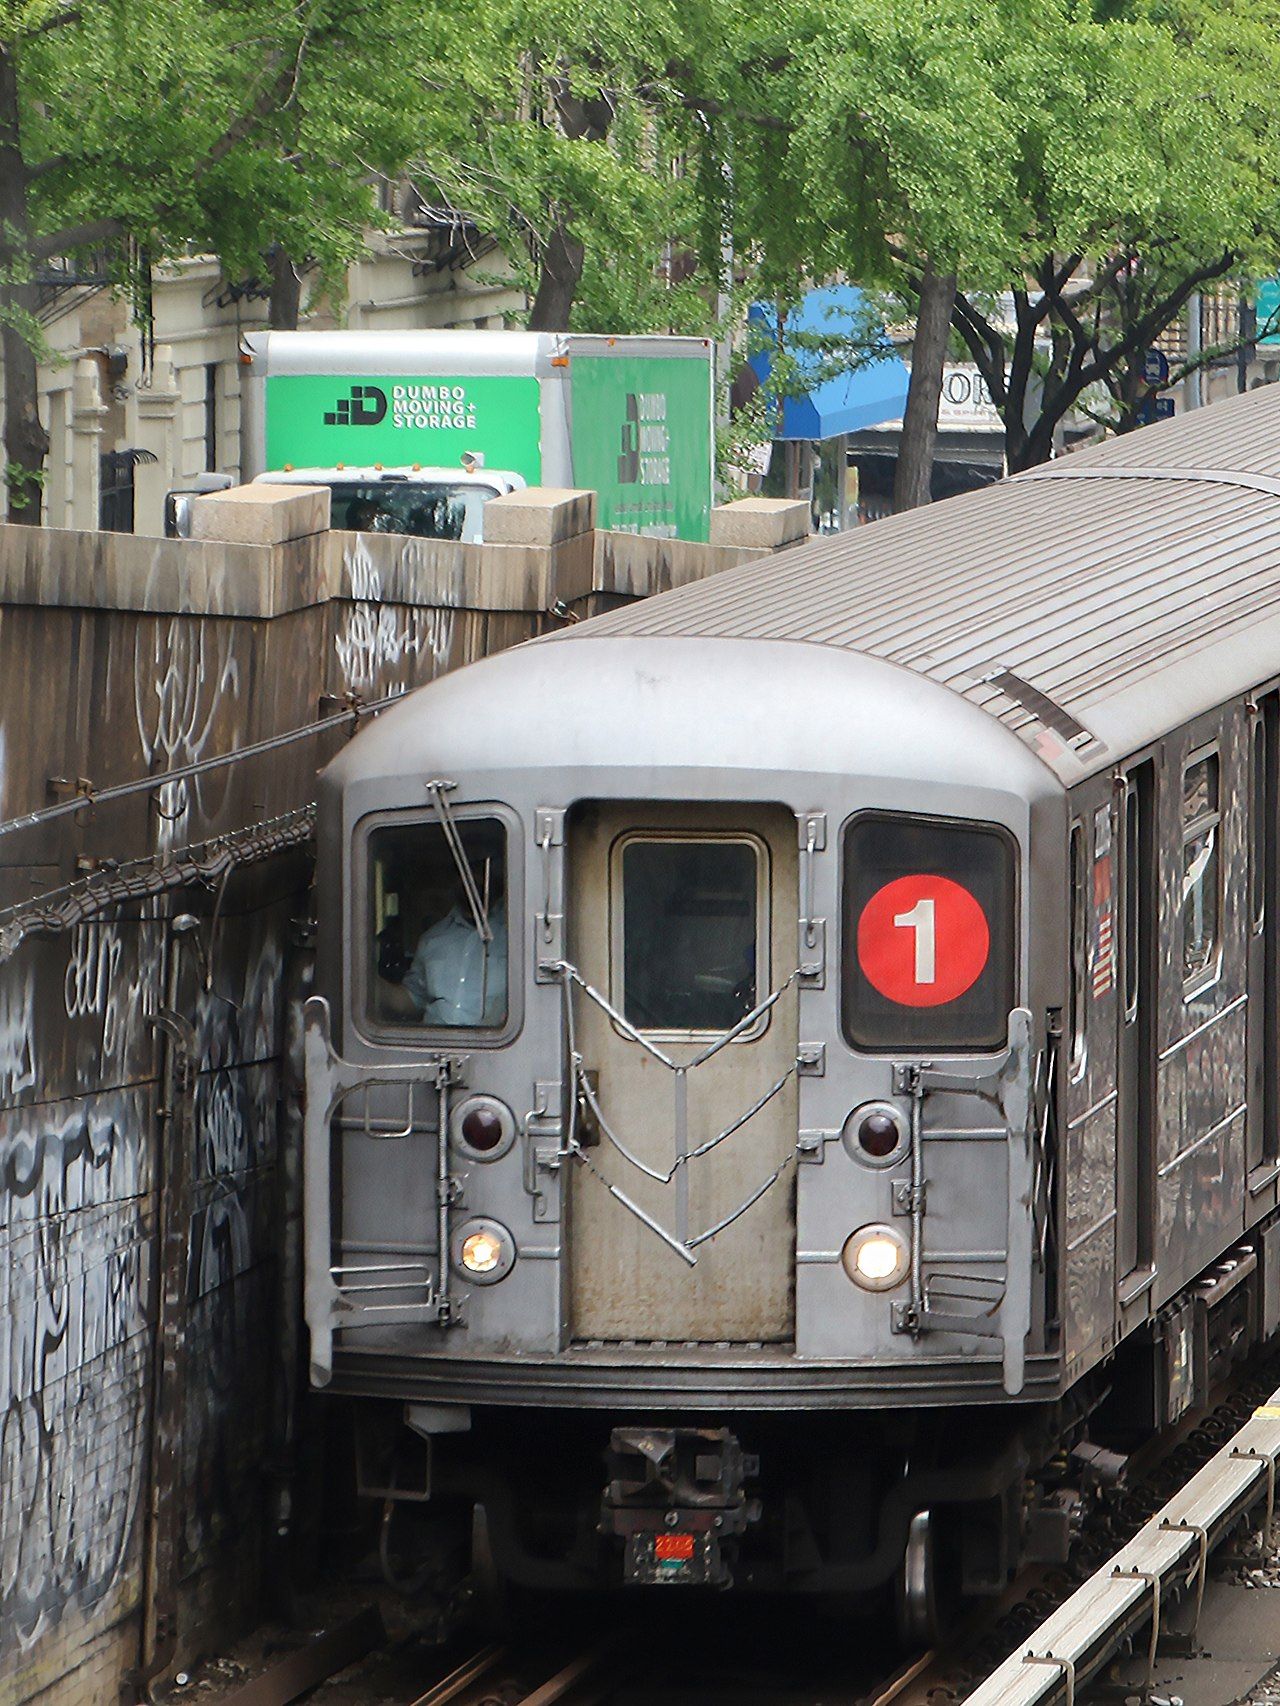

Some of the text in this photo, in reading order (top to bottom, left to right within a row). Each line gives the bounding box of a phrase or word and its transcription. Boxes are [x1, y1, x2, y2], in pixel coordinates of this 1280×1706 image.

[392, 385, 466, 400] DUMBO
[392, 415, 477, 428] STORAGE
[894, 899, 935, 984] 1
